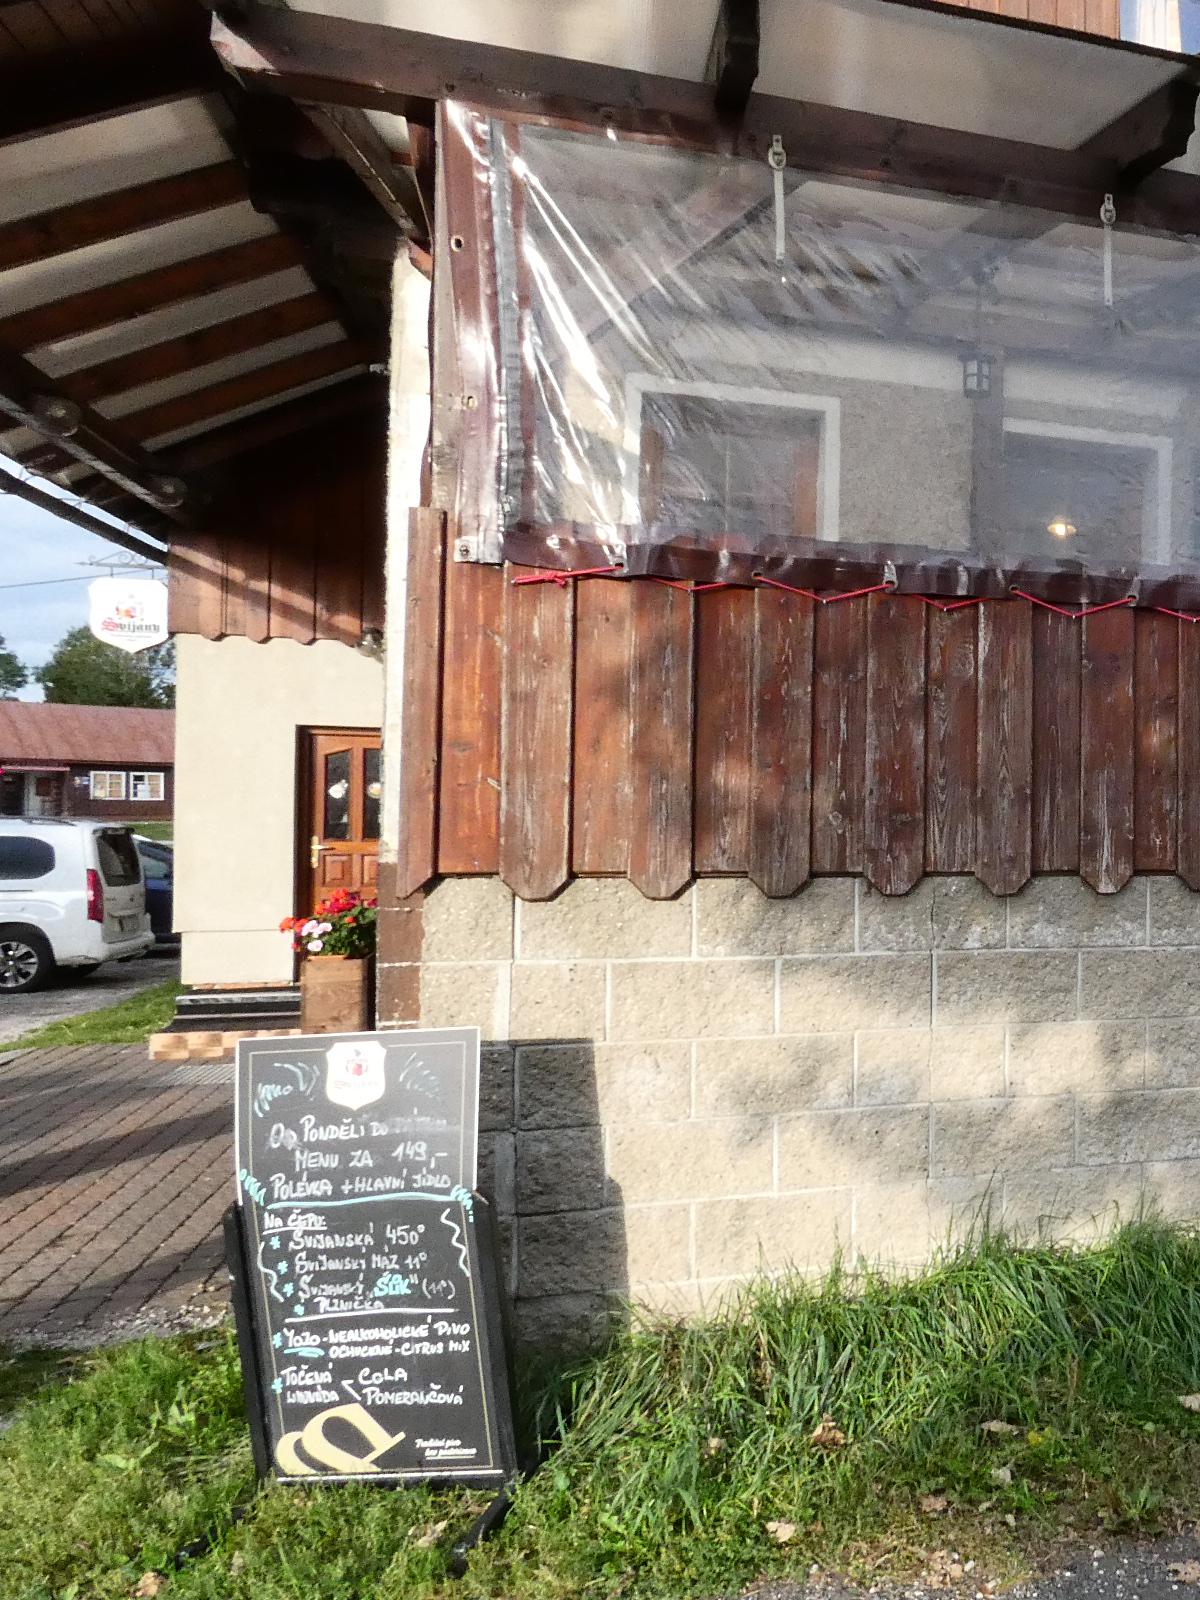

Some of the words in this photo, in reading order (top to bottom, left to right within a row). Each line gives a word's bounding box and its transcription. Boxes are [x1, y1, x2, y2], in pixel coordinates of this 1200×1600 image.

[370, 1121, 389, 1136] DO
[294, 1150, 339, 1171] MENU
[349, 1150, 373, 1167] ZA
